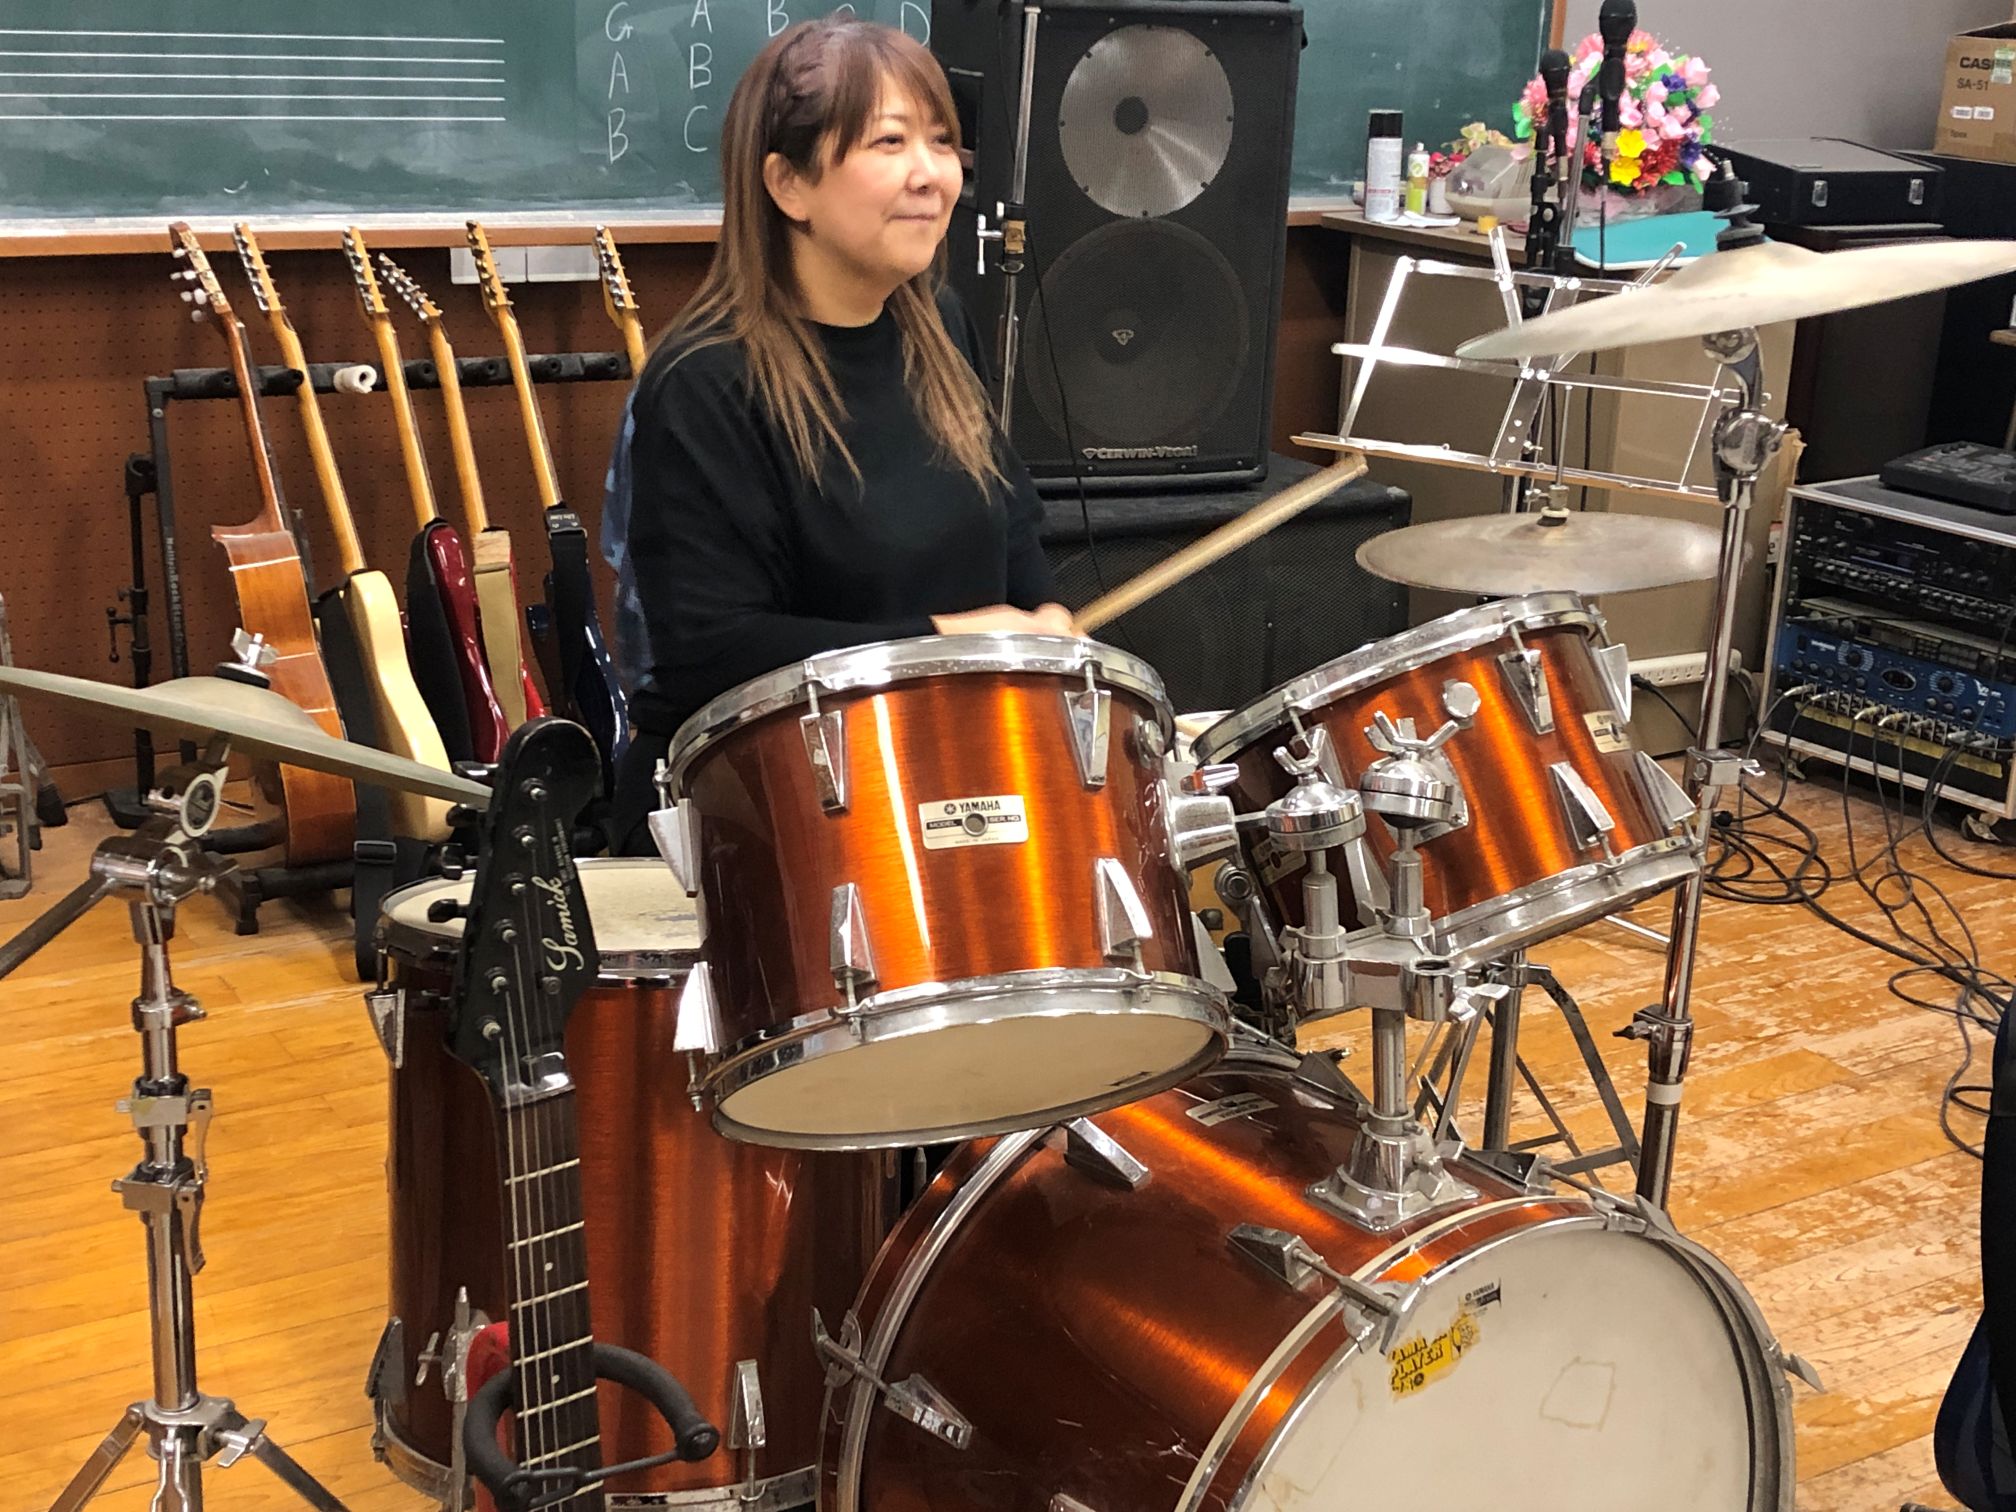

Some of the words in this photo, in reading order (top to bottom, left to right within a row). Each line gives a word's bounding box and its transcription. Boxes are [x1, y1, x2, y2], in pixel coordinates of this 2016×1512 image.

[606, 2, 633, 42] G
[691, 0, 713, 34] A
[767, 0, 790, 37] B
[608, 51, 629, 99] A
[689, 43, 713, 90] B
[1956, 77, 1989, 91] SA-51
[607, 107, 629, 164] B
[683, 105, 708, 153] C
[959, 800, 1001, 813] YAMAHA
[531, 875, 585, 971] Samick
